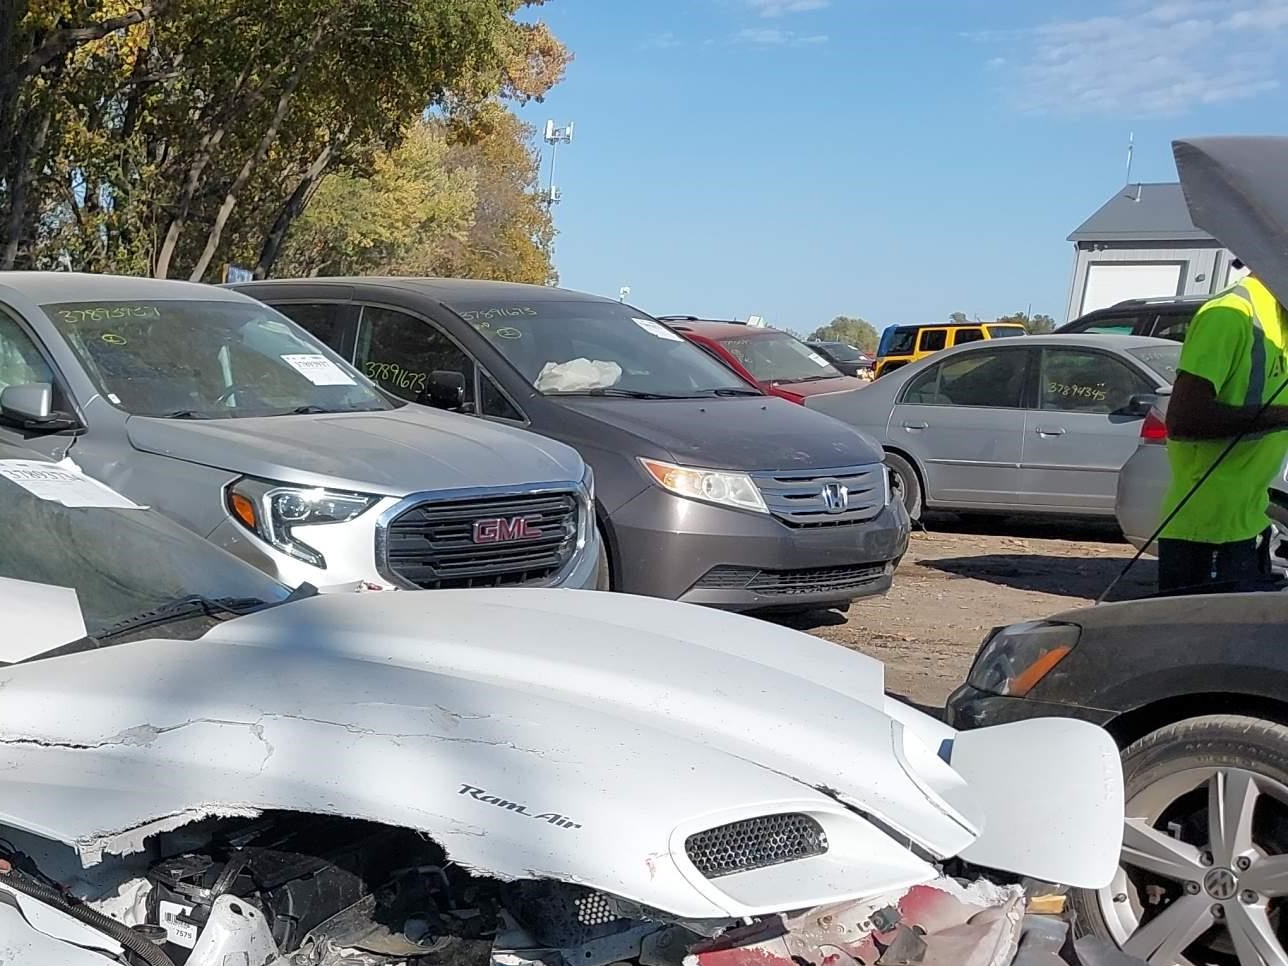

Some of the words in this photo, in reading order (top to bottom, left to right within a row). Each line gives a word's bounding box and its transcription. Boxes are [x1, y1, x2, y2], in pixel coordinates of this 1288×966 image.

[366, 361, 427, 391] 37891673
[1048, 382, 1107, 401] 37894345
[473, 514, 543, 544] GMC
[458, 783, 532, 816] Ram
[533, 813, 582, 829] Air
